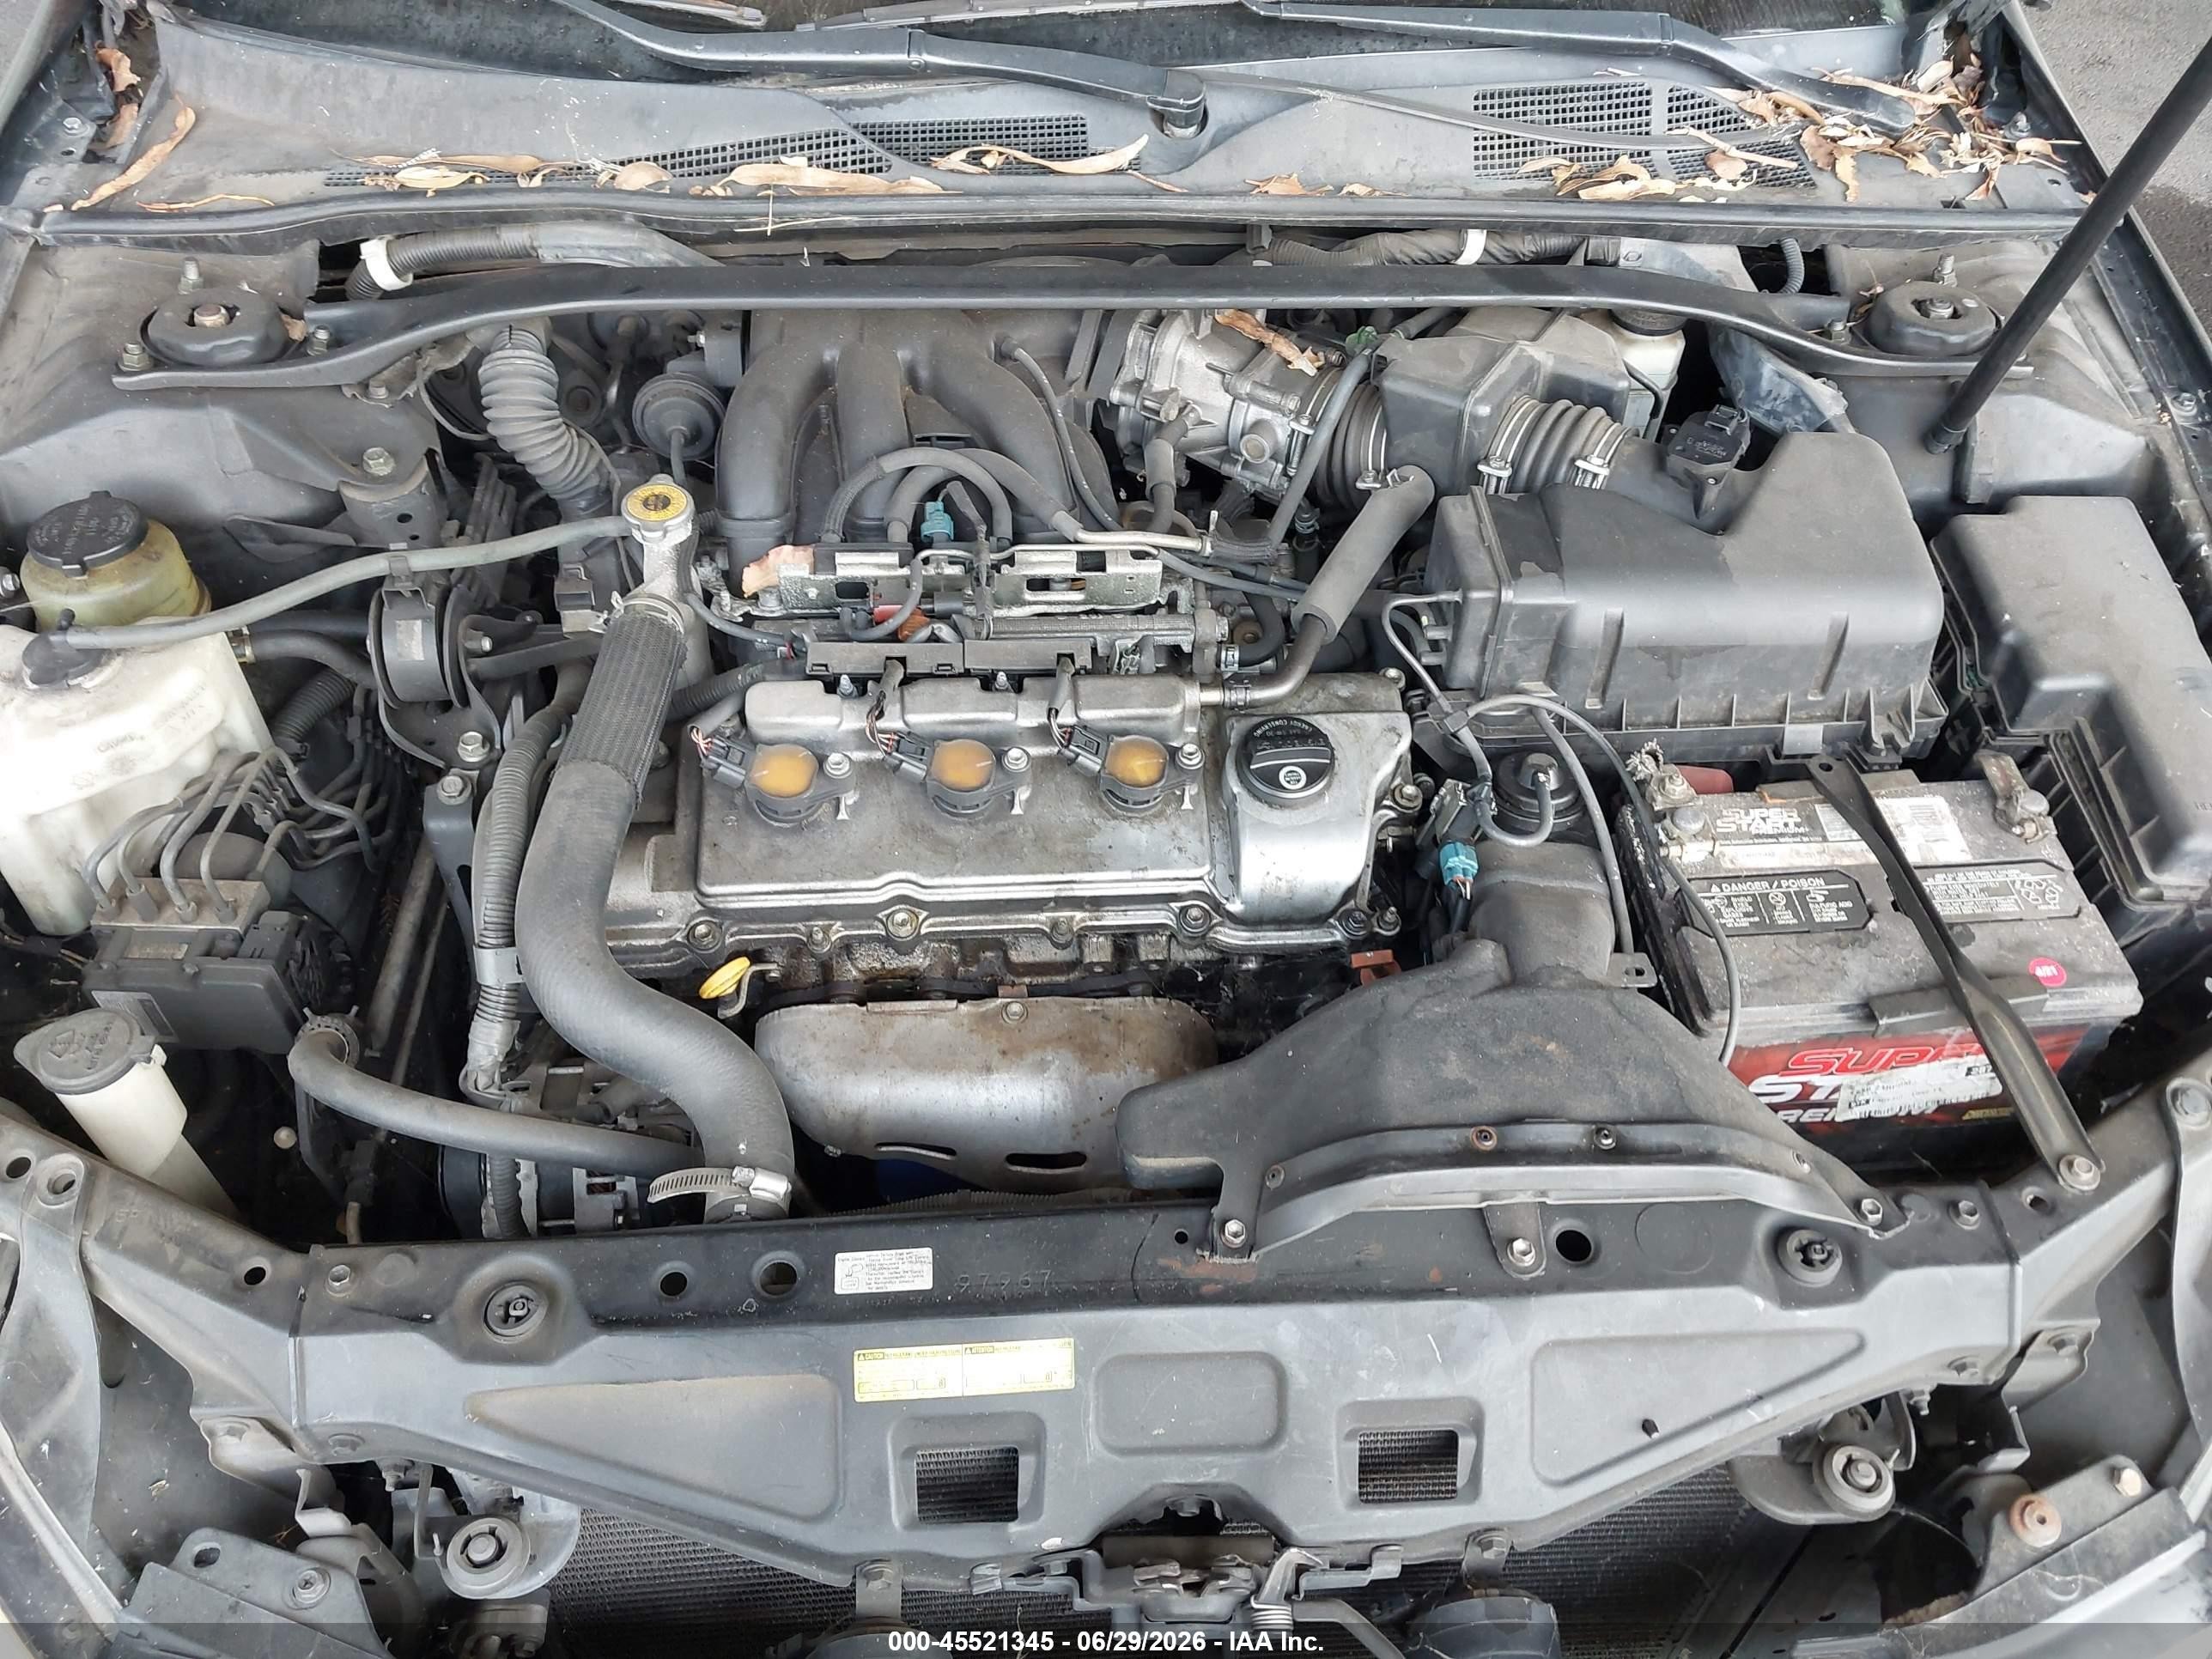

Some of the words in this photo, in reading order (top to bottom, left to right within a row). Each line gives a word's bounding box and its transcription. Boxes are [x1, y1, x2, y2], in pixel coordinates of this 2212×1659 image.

[1722, 807, 1798, 820] SUPER
[1717, 817, 1802, 832] START
[1722, 880, 1770, 893] DANGER
[1781, 878, 1826, 889] POISON
